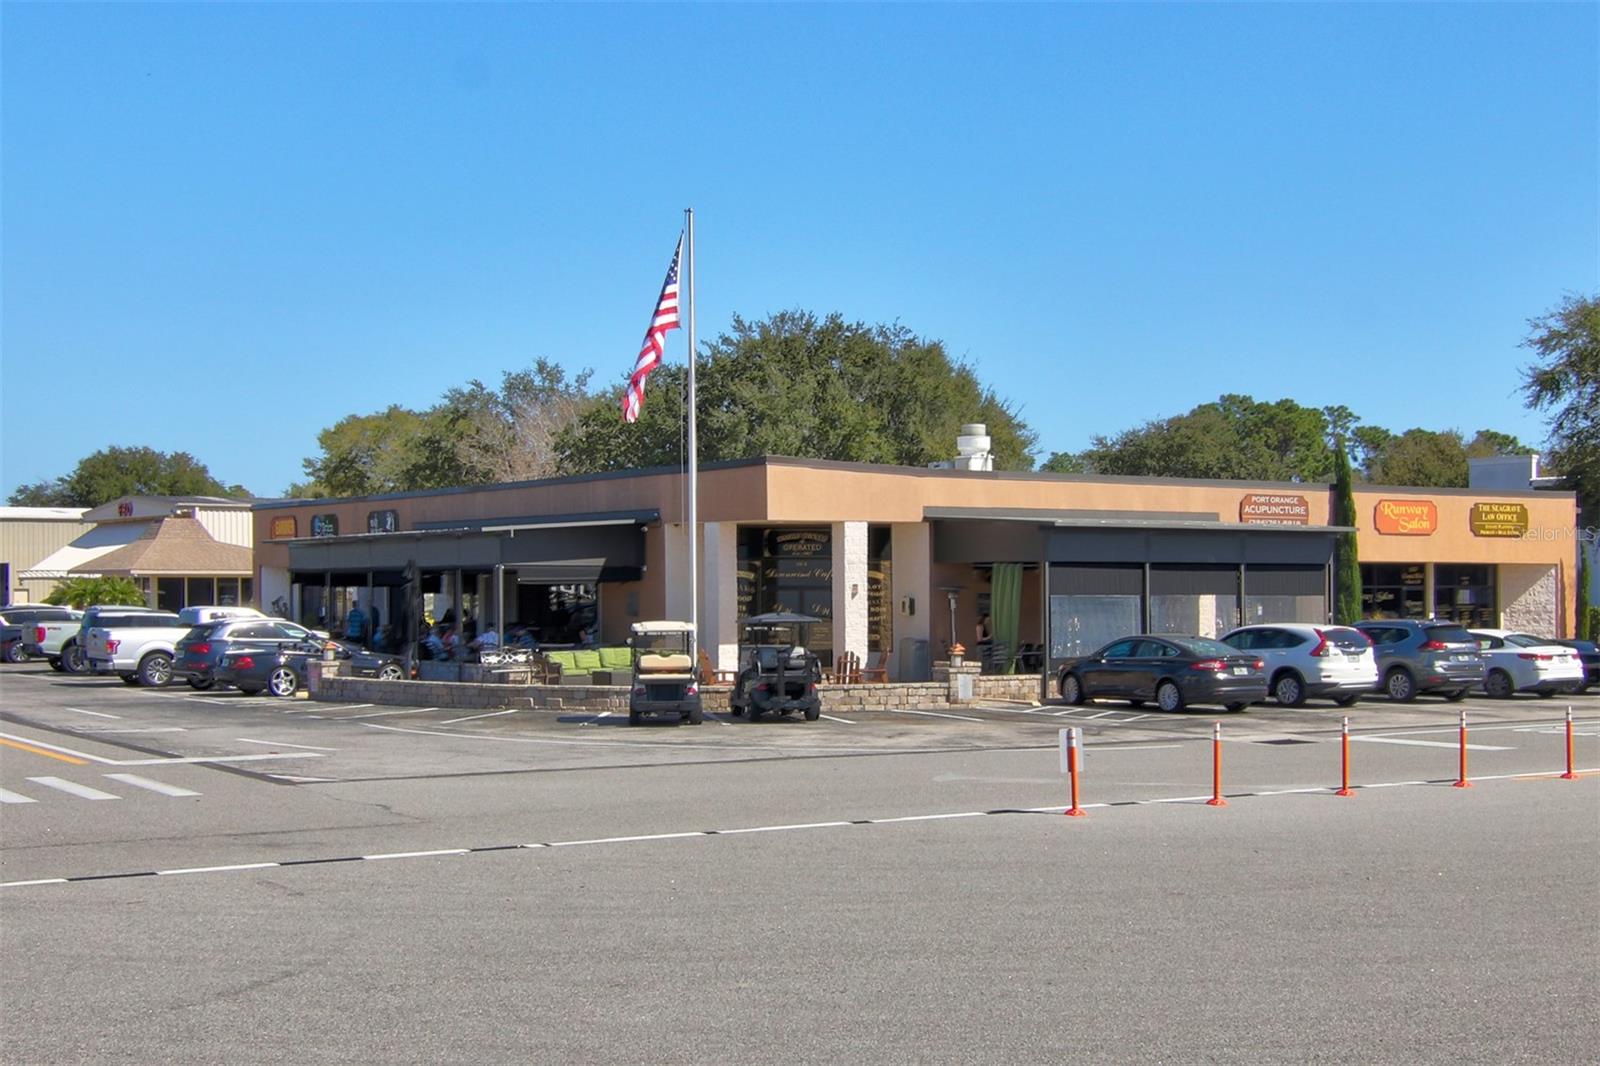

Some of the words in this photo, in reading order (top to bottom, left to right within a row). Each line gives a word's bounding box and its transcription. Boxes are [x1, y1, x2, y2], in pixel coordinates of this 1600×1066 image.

[1270, 496, 1299, 504] ORANGE
[1244, 505, 1306, 515] ACUPUNCTURE
[1381, 502, 1429, 520] Runway
[1482, 512, 1495, 521] LAW
[1398, 516, 1430, 532] Salon
